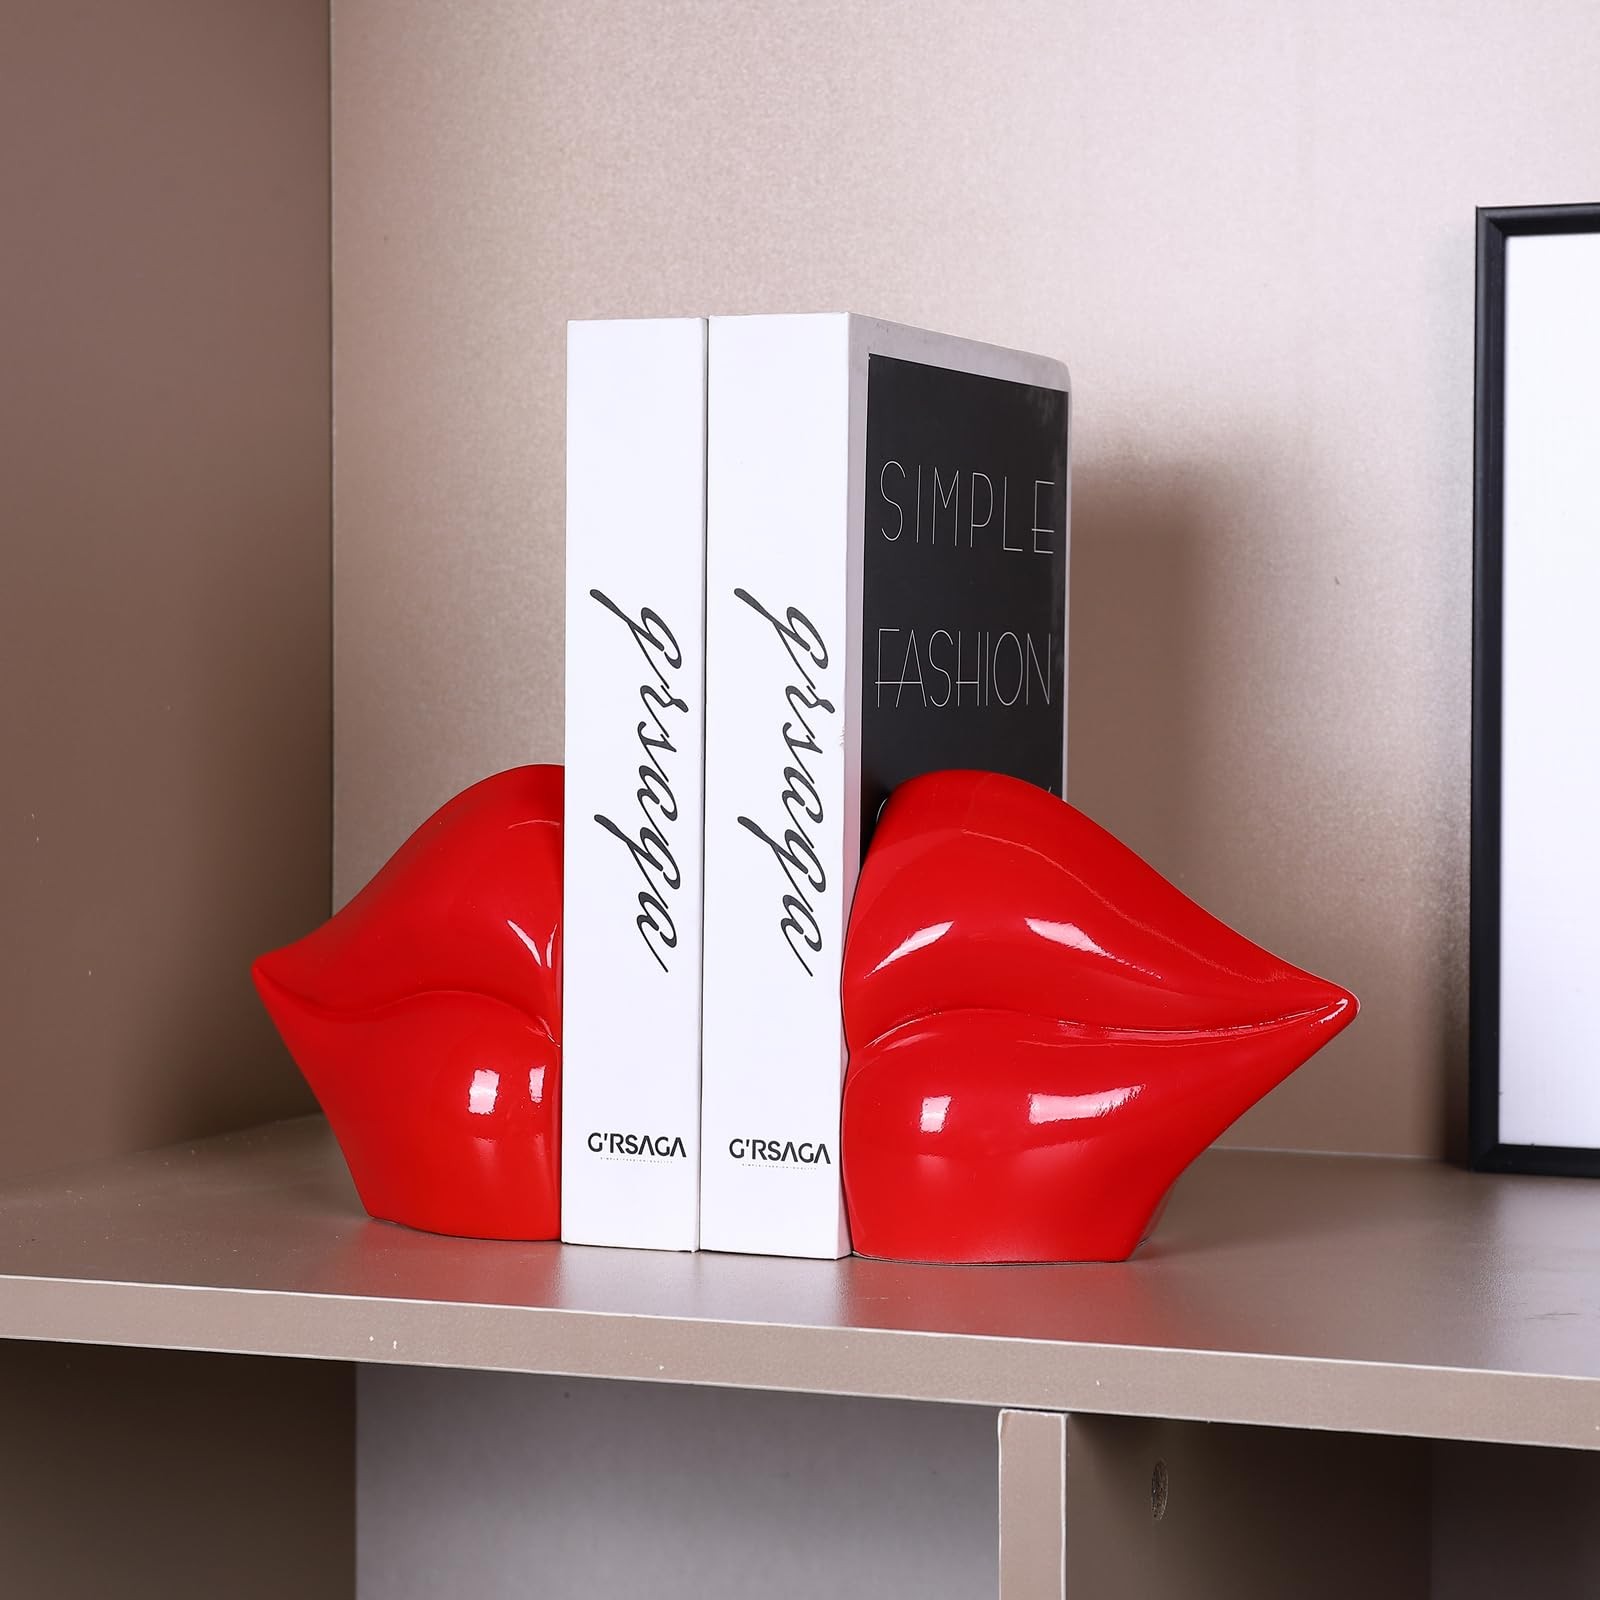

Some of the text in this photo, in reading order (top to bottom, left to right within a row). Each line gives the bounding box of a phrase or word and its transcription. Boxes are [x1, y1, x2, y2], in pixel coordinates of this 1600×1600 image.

[880, 460, 1055, 554] SIMPLE
[874, 628, 1051, 708] FASHION
[590, 588, 689, 972] grsaga
[734, 587, 836, 977] grsaga
[588, 1132, 686, 1158] G'RSAGA
[729, 1138, 831, 1164] G'RSAGA
